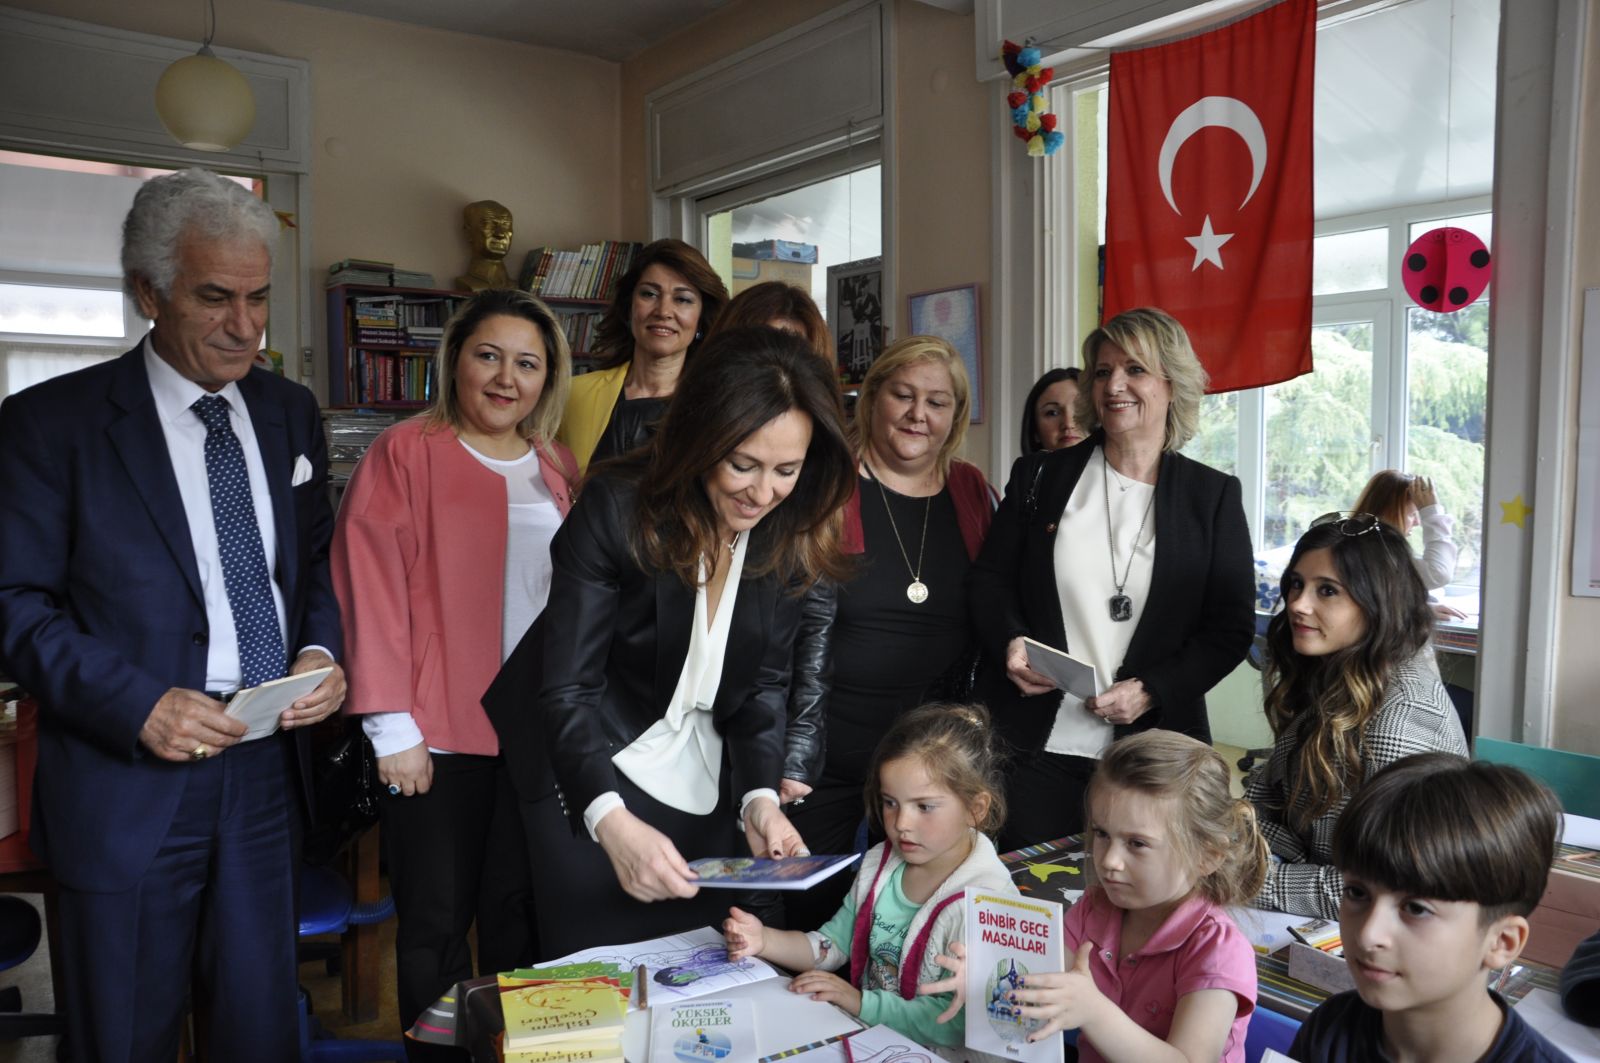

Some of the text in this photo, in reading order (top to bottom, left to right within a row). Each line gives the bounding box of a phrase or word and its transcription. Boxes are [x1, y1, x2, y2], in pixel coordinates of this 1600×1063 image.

[978, 909, 1049, 938] BİNBİR GECE
[981, 928, 1046, 956] MASALLARI
[671, 1015, 732, 1029] ÖKÇELER
[676, 1007, 728, 1019] YÜKSEK
